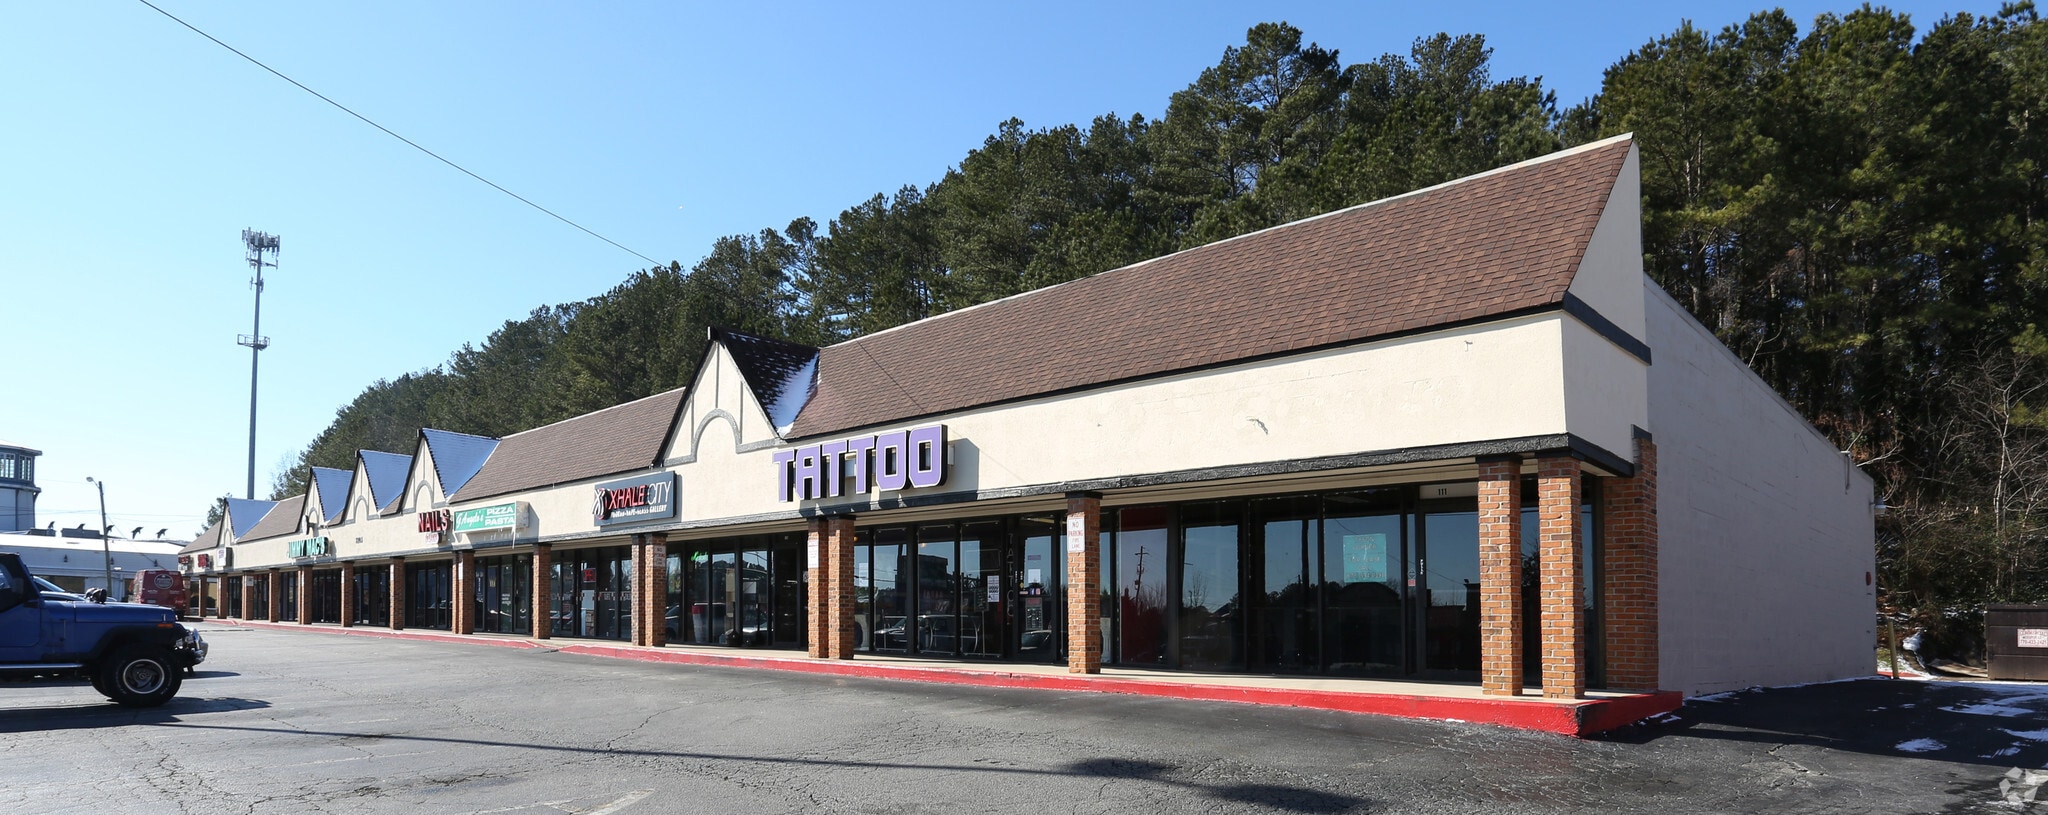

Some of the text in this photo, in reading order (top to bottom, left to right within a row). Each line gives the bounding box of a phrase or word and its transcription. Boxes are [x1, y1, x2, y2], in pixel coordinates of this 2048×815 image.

[772, 424, 946, 502] TATTOO
[608, 481, 671, 510] XHALE CITY
[1438, 488, 1447, 496] 111
[486, 506, 514, 516] PIZZA
[418, 509, 450, 533] NAILS
[485, 516, 516, 526] PASTA
